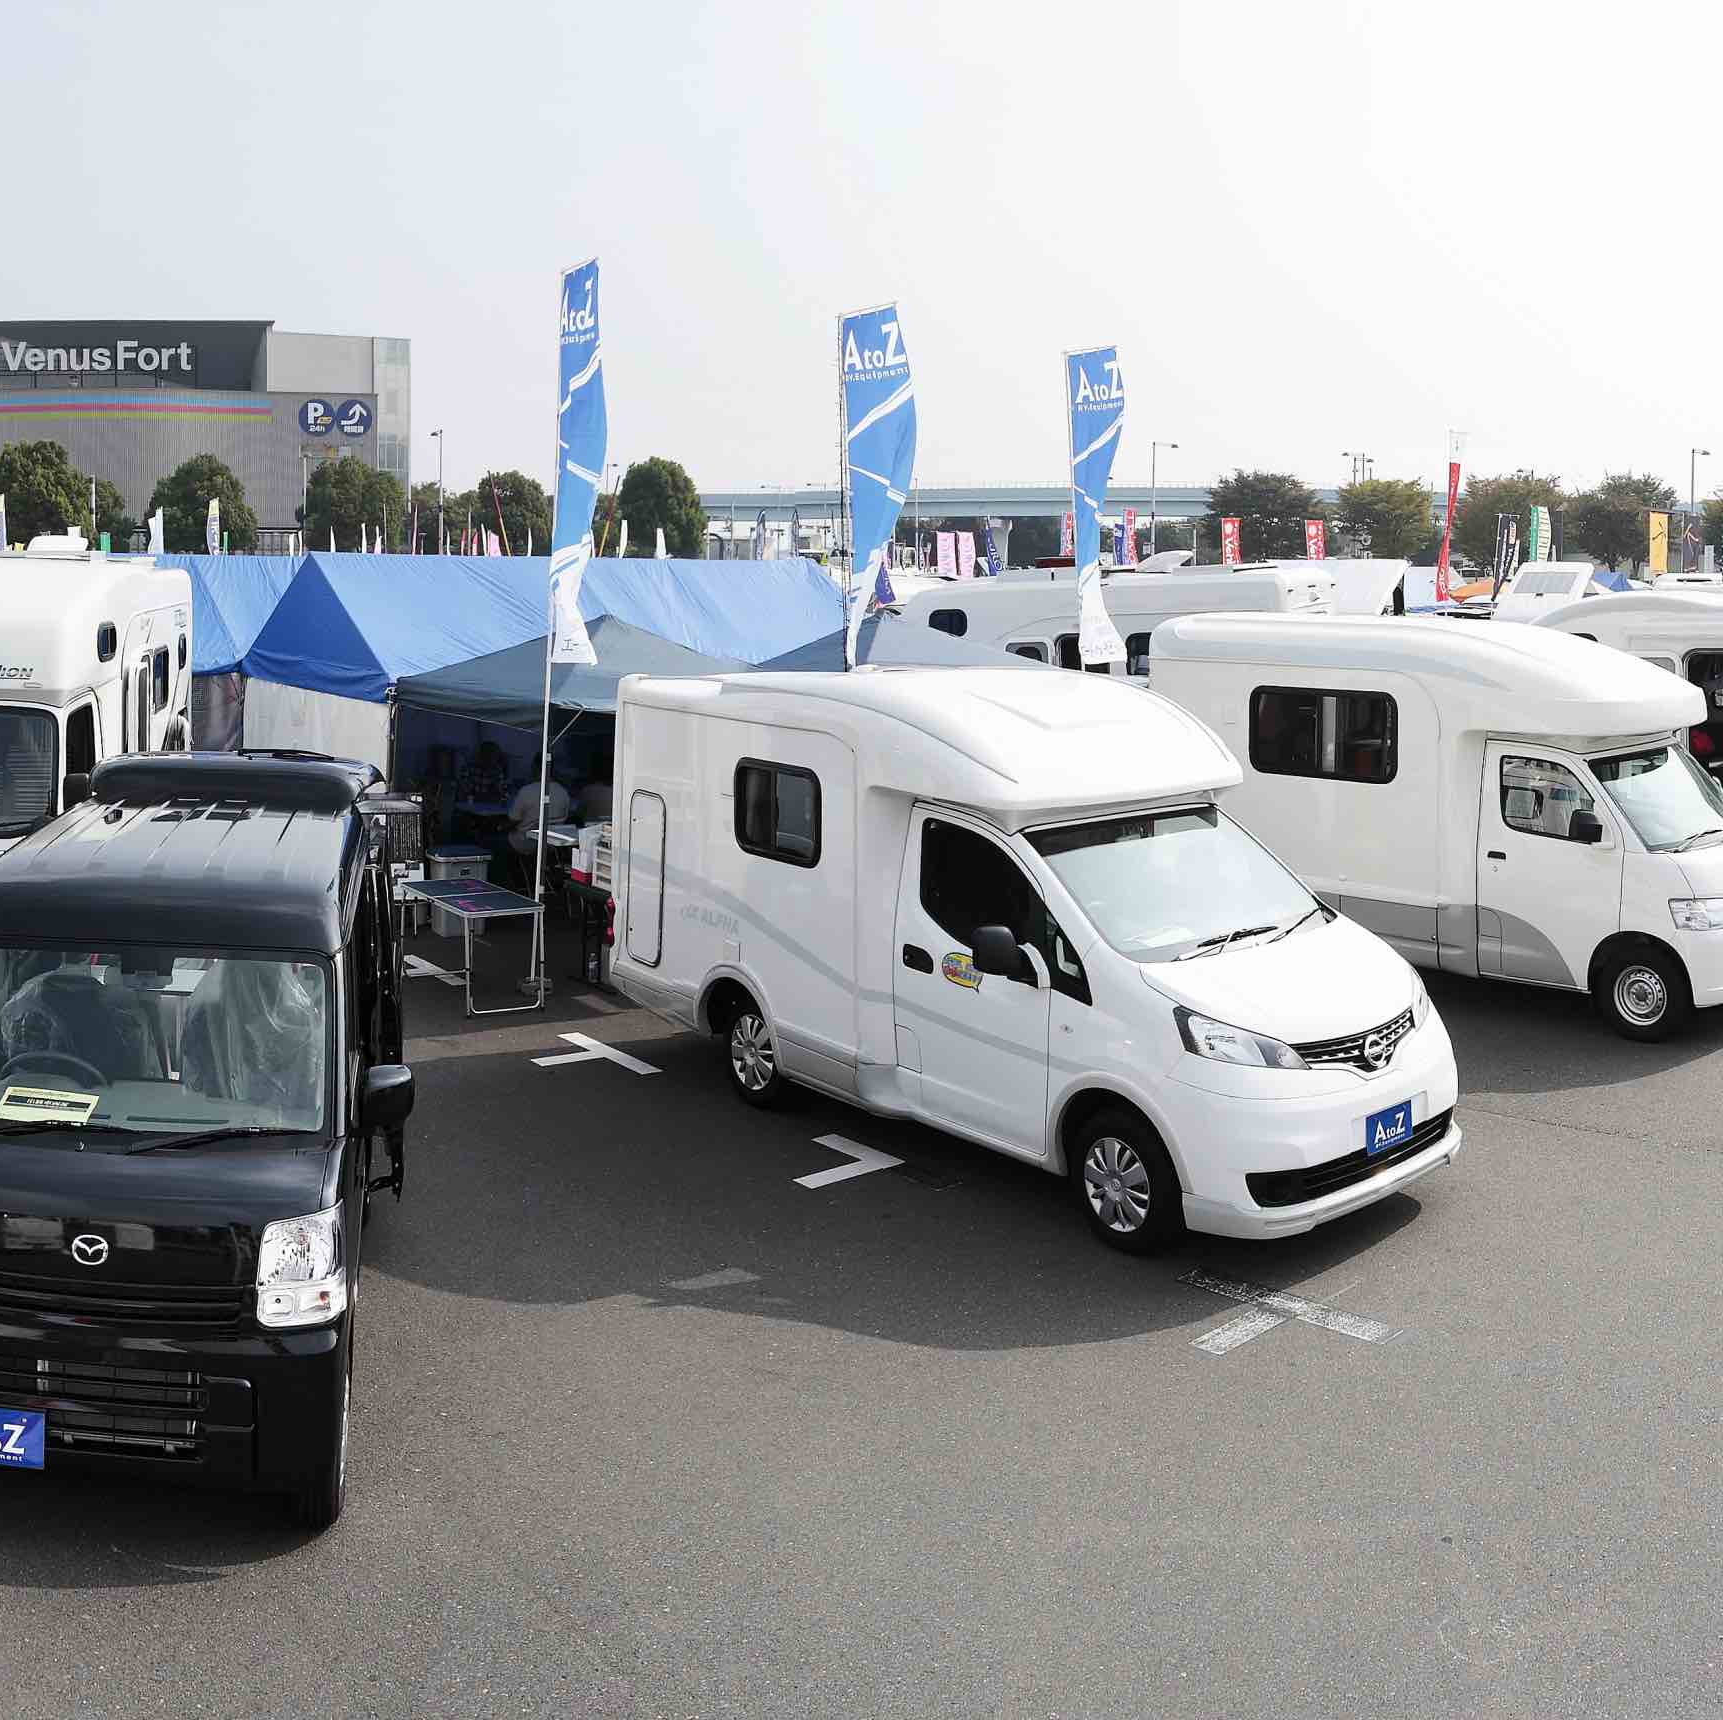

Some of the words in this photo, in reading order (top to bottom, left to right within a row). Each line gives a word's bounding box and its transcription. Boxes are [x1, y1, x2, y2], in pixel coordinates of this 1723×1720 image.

[2, 341, 111, 371] Venus
[116, 340, 192, 371] Fort
[844, 320, 906, 370] AtoZ
[307, 402, 324, 424] P
[1374, 1111, 1405, 1144] AtoZ
